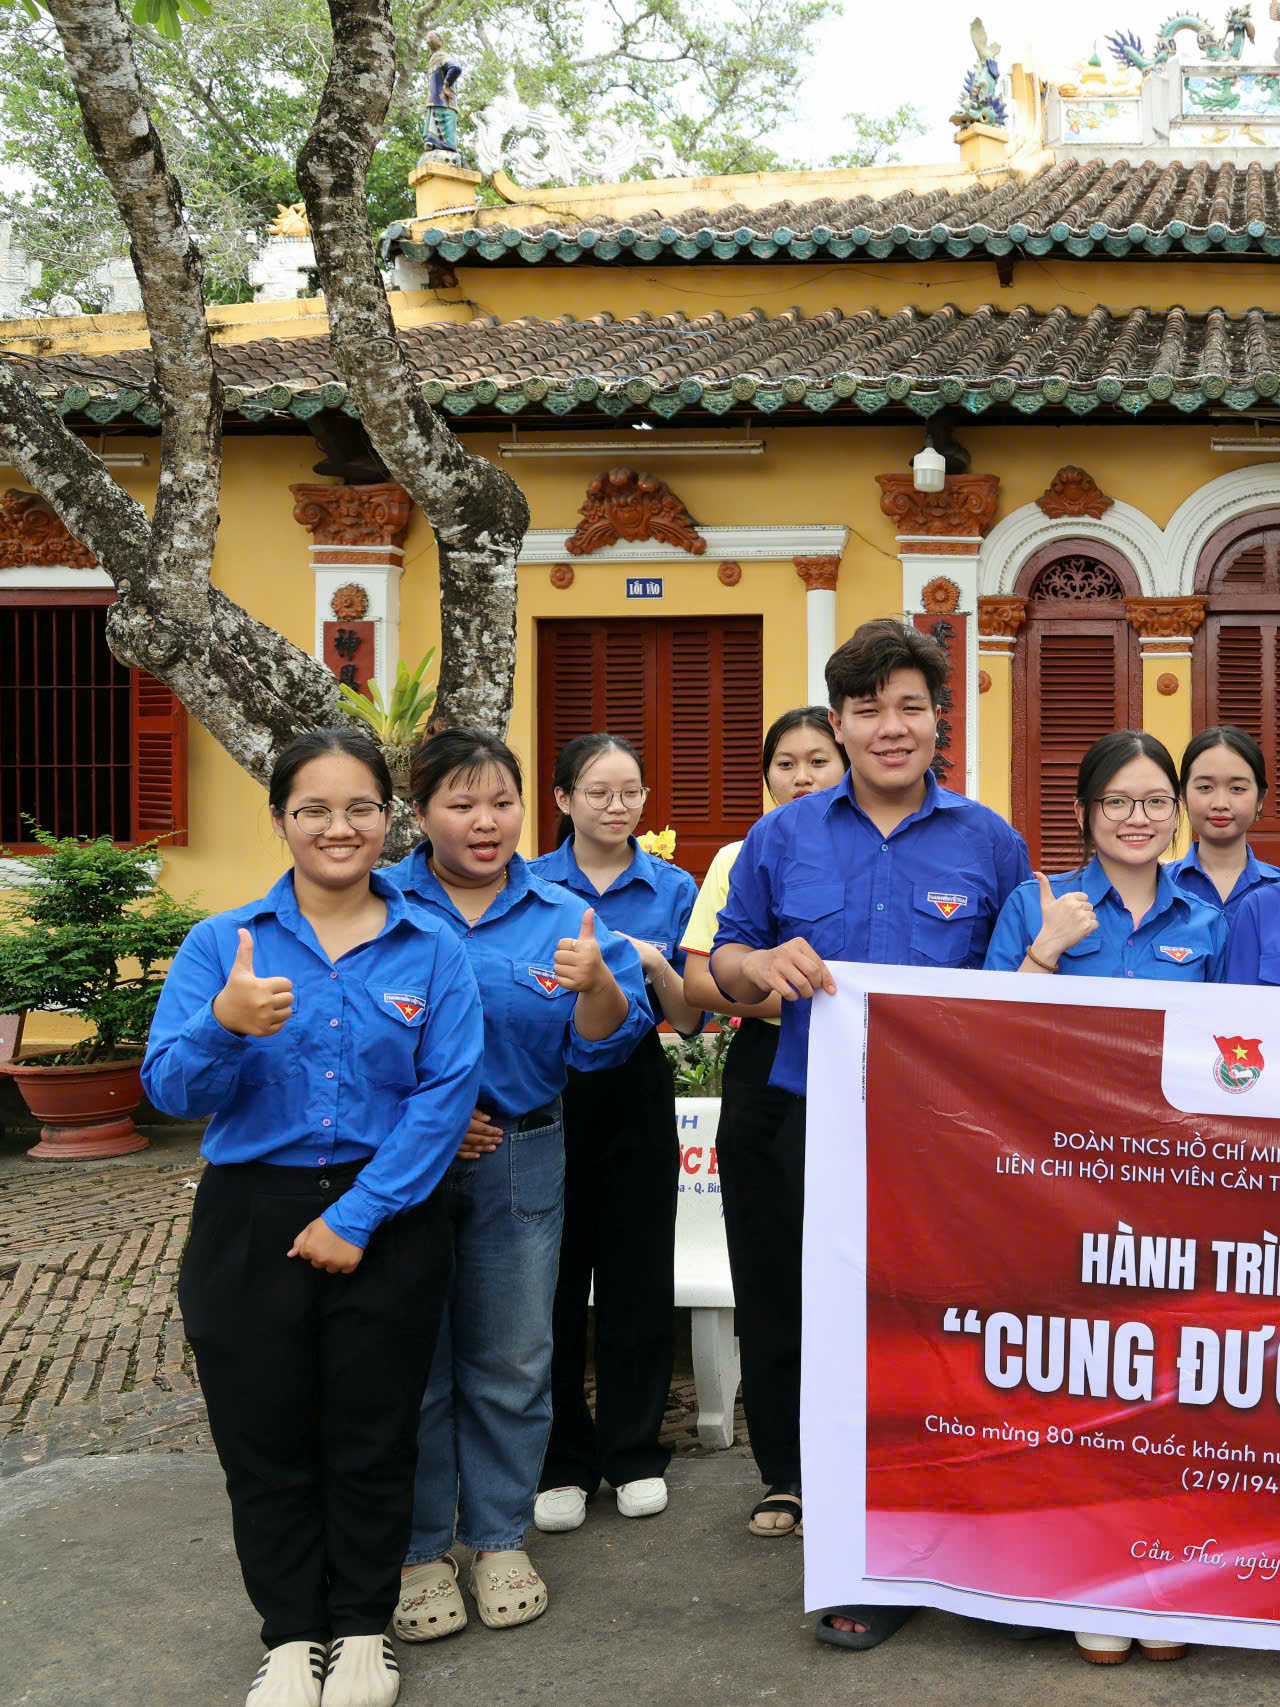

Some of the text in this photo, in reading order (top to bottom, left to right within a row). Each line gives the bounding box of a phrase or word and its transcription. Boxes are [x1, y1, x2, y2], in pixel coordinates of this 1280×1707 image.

[629, 580, 660, 595] LỐI VÀO
[675, 1115, 698, 1129] H
[1053, 1130, 1114, 1151] ĐOÀN
[1119, 1136, 1170, 1156] TNCS
[1176, 1131, 1207, 1159] HỒ
[1212, 1139, 1247, 1161] CHÍ
[996, 1153, 1035, 1175] LIÊN
[1041, 1159, 1073, 1177] CHI
[1079, 1158, 1114, 1184] HỘI
[1120, 1164, 1165, 1184] SINH
[1170, 1165, 1215, 1187] VIÊN
[1220, 1166, 1263, 1190] CẦN
[694, 1183, 705, 1194] Q.
[1081, 1220, 1196, 1290] HÀNH
[943, 1307, 1155, 1401] “CUNG
[925, 1414, 976, 1438] Chào
[982, 1421, 1040, 1447] mừng
[1046, 1426, 1074, 1445] 80
[1080, 1431, 1125, 1451] năm
[1131, 1433, 1185, 1457] Quốc
[1192, 1440, 1256, 1463] khánh
[1130, 1539, 1175, 1562] Cần
[1183, 1538, 1227, 1568] Thơ,
